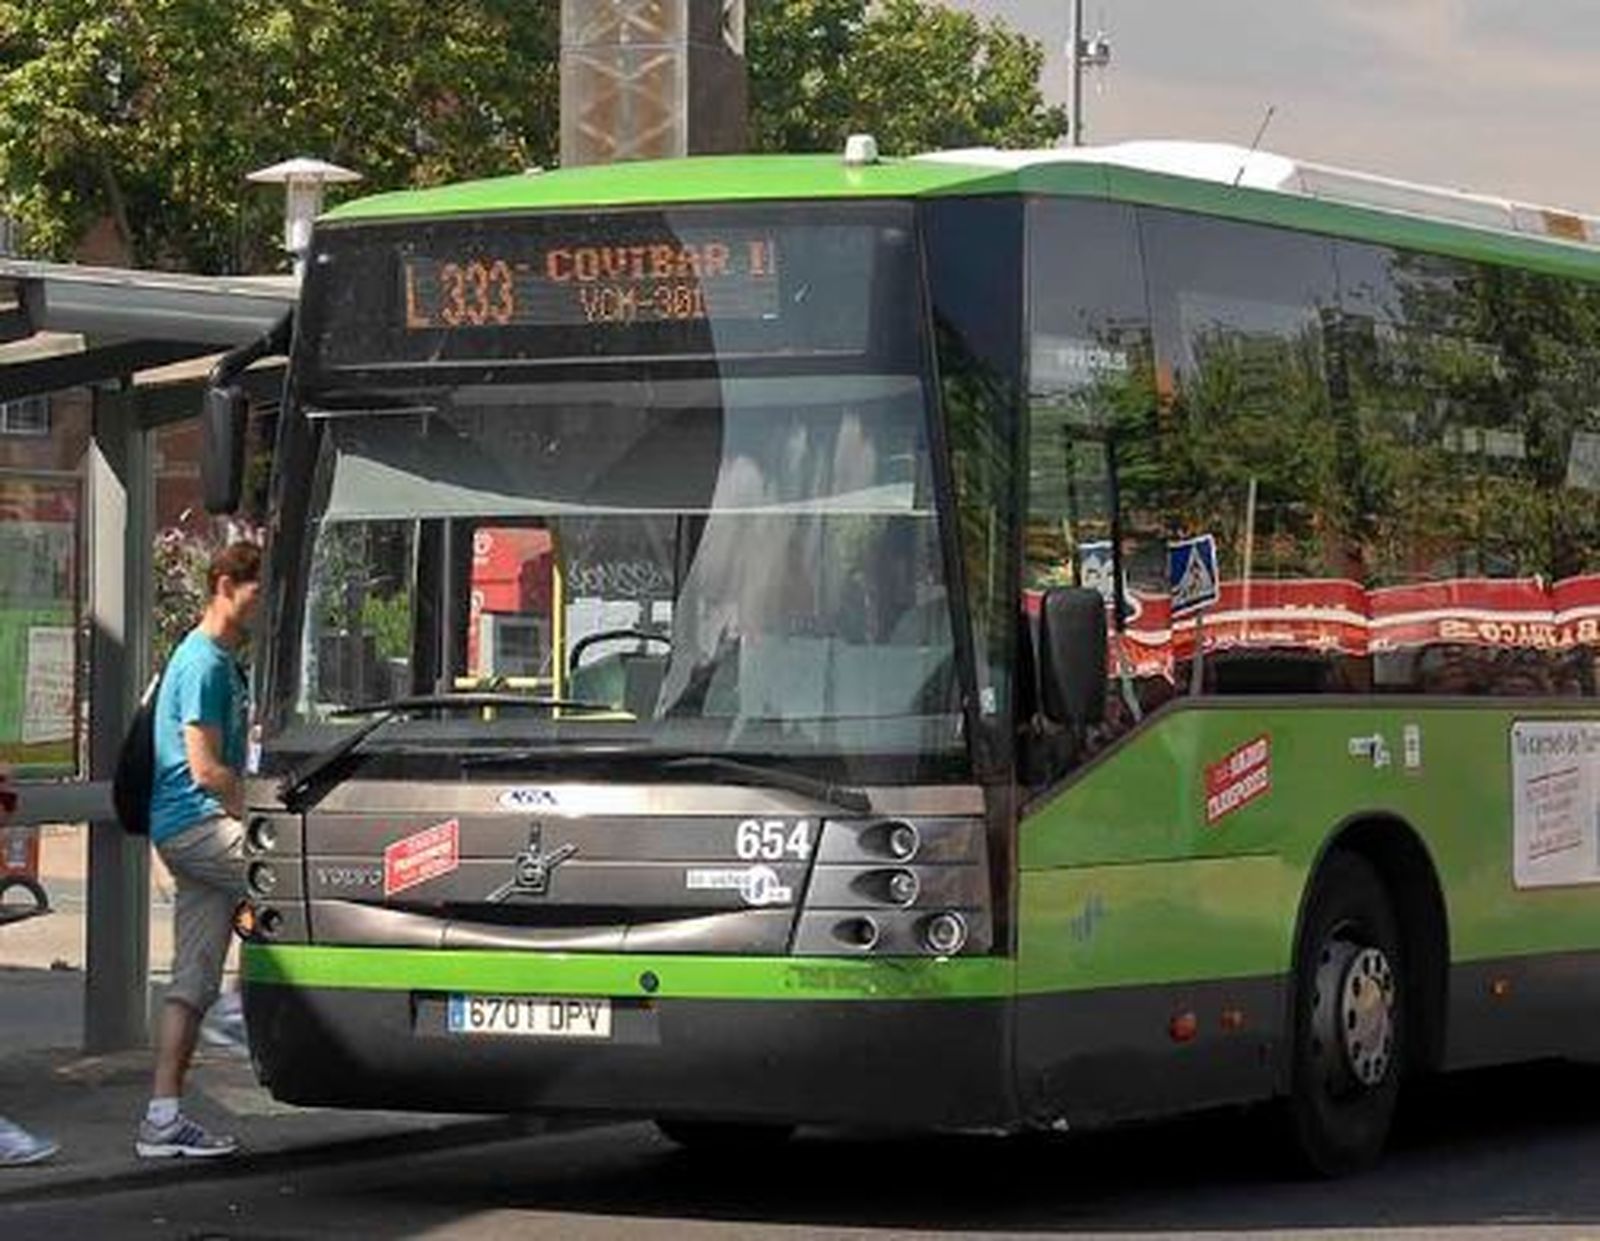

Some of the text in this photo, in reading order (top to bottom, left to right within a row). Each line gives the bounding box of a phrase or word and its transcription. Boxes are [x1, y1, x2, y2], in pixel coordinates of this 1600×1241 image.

[405, 263, 431, 329] L
[441, 259, 513, 326] 333
[735, 818, 814, 860] 654
[469, 998, 535, 1029] 6701
[548, 1000, 602, 1032] DPV
